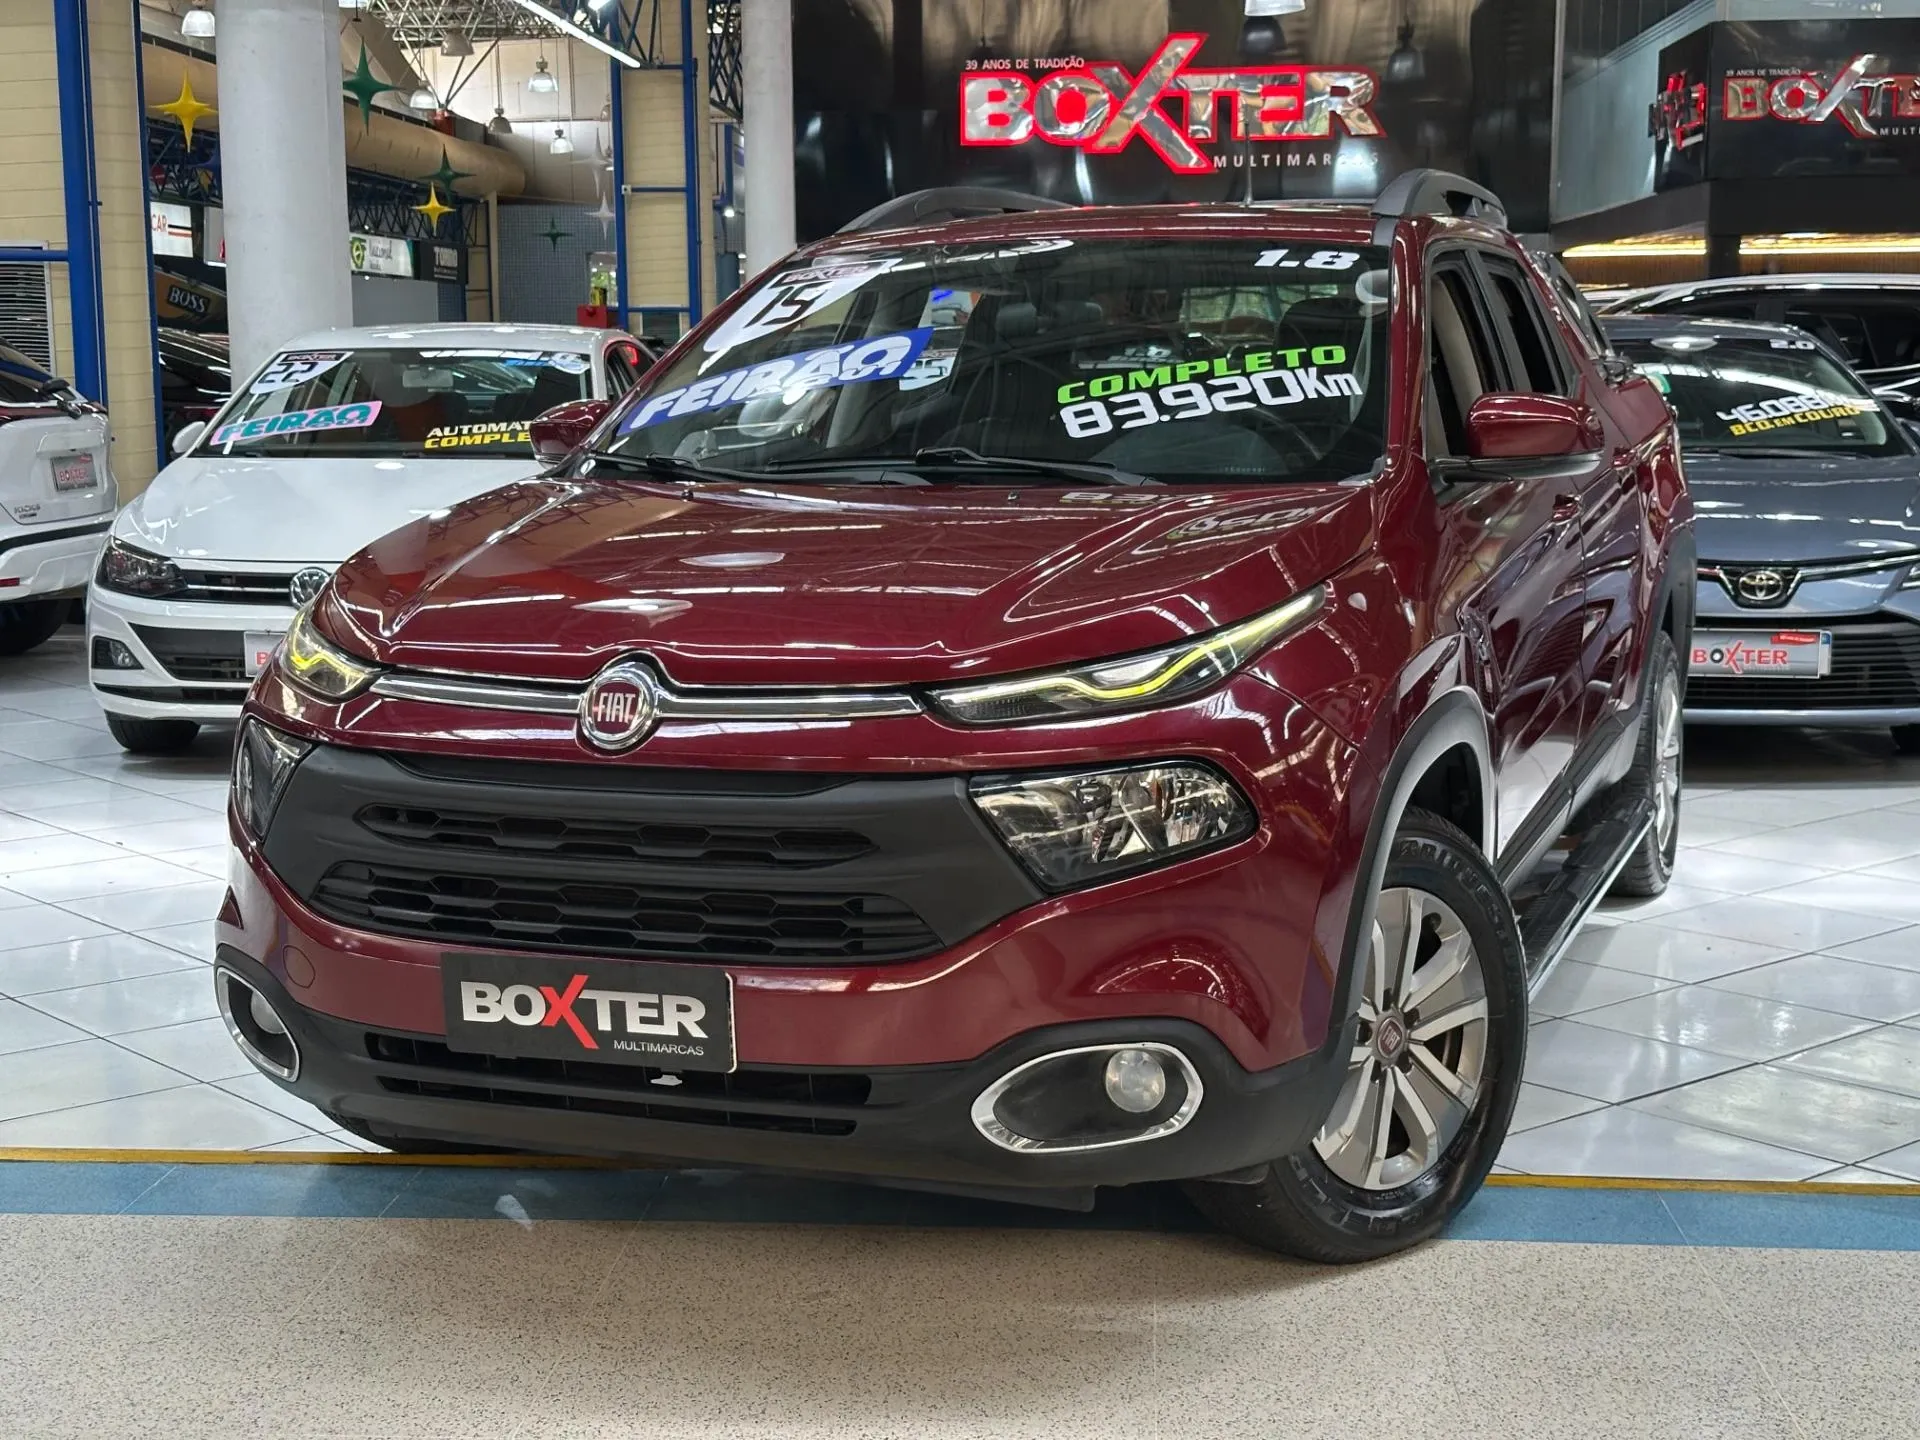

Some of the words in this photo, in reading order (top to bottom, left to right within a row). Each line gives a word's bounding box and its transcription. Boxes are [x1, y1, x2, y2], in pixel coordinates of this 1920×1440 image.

[964, 60, 978, 70] 39
[982, 60, 1011, 70] ANOS
[1015, 59, 1029, 69] DE
[1033, 55, 1085, 70] TRADIÇÃO
[960, 32, 1387, 174] BOXTER
[1722, 53, 1920, 138] BOXTE
[1880, 127, 1920, 136] MULT
[1254, 249, 1360, 271] 1.8
[169, 286, 206, 313] BOSS
[1769, 339, 1816, 350] 2.0
[1057, 345, 1346, 404] COMPLETO
[1059, 367, 1364, 438] 83.920Km
[424, 431, 531, 449] COMPLE
[427, 420, 531, 438] AUTOMAT
[1692, 640, 1788, 673] BOXTER
[597, 692, 636, 725] FIAT
[459, 974, 709, 1050] BOXTER
[613, 1039, 704, 1056] MULTIMARCAS
